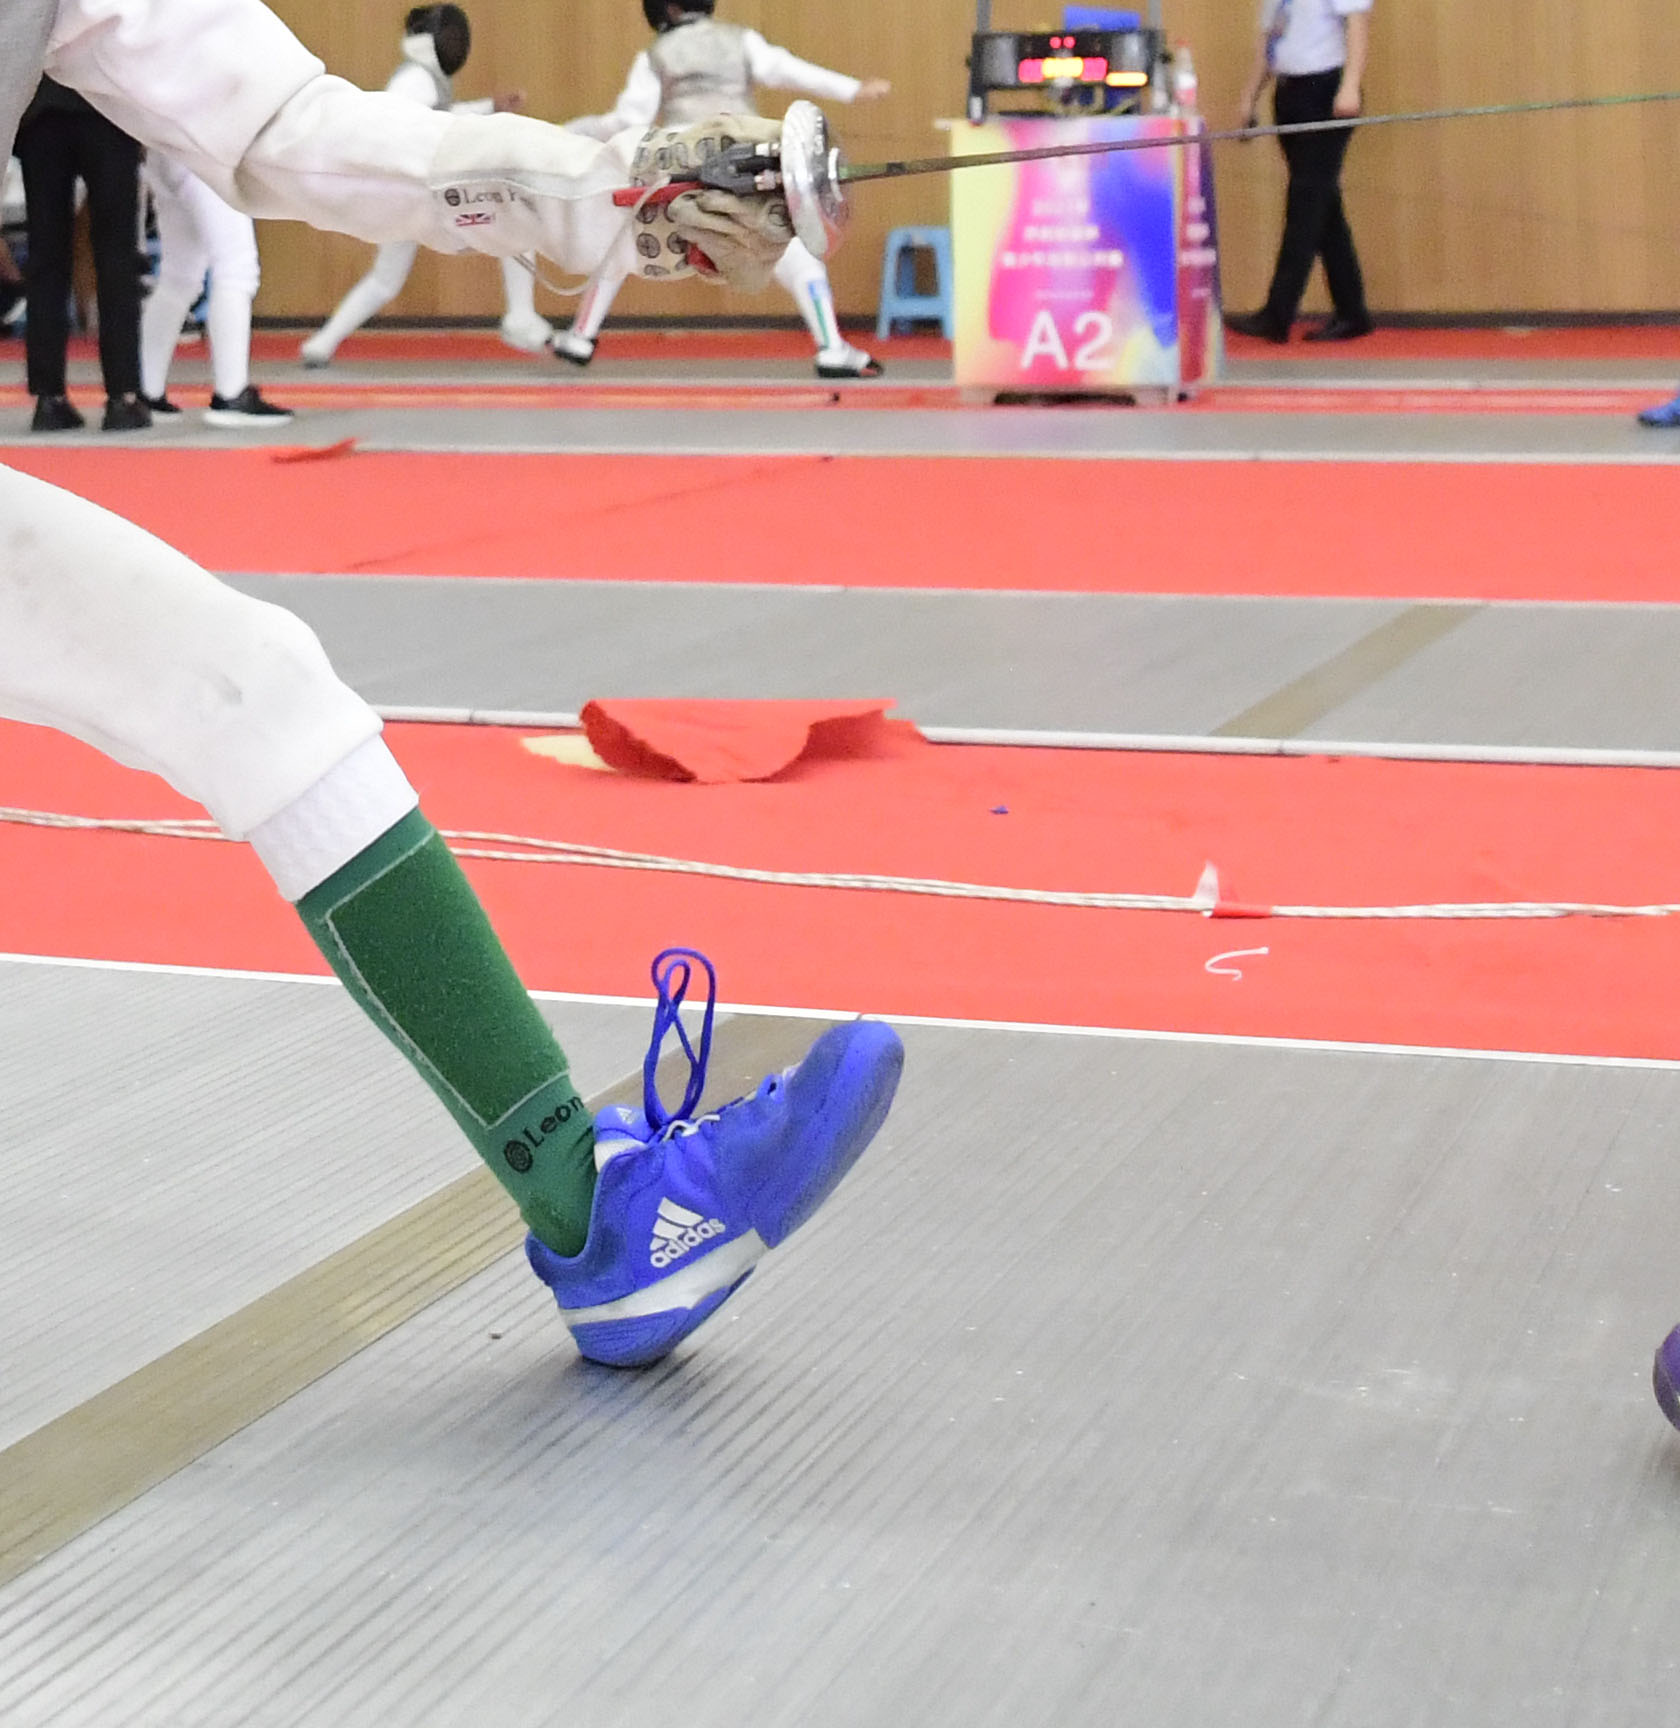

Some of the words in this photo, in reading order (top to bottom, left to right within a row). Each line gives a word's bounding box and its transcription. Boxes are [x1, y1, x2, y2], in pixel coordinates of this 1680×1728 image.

[1020, 308, 1113, 371] A2
[523, 1095, 585, 1148] Leon
[650, 1218, 726, 1268] adidas
